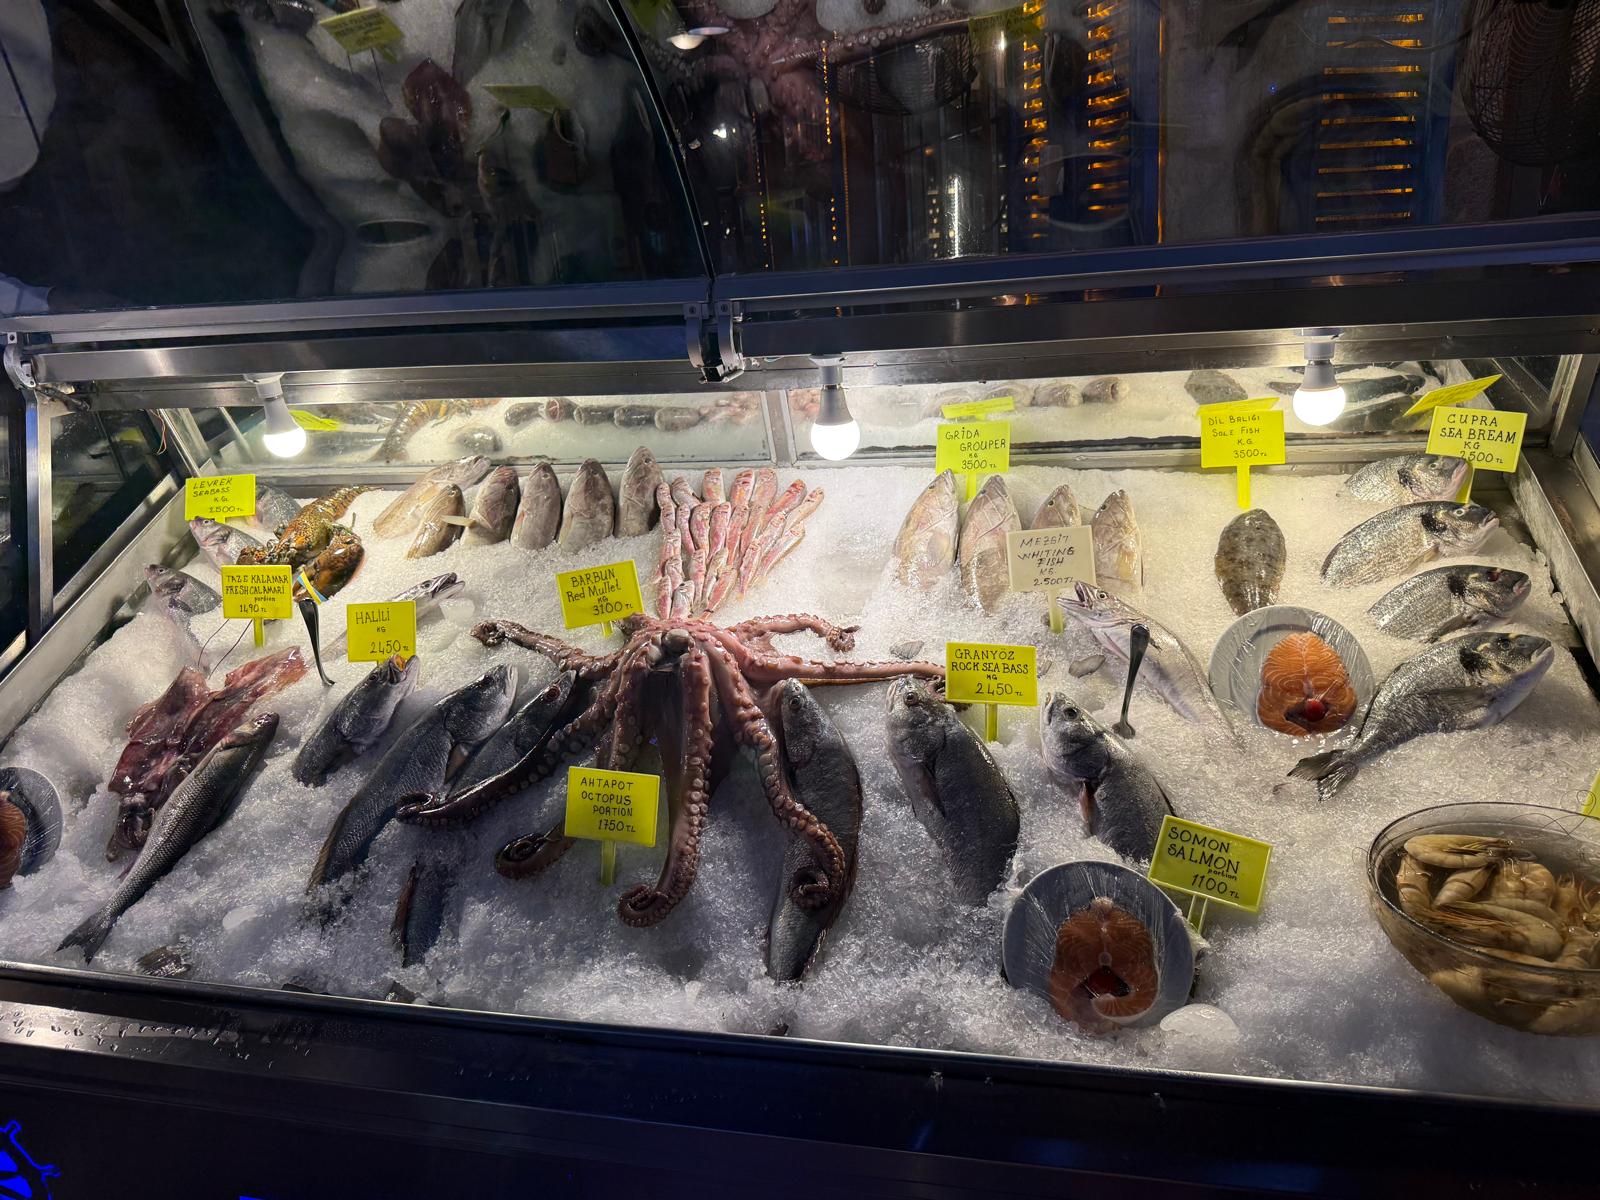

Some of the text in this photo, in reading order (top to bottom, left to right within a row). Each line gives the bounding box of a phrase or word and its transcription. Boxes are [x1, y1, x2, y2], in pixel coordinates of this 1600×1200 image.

[1447, 414, 1498, 427] CUPRA
[945, 427, 979, 440] GRİDA
[1212, 429, 1234, 437] SOLE
[1440, 427, 1517, 444] SEA BREAM
[960, 439, 1006, 451] GROUPER
[1464, 441, 1480, 449] KG
[1233, 449, 1259, 458] 3500
[1460, 450, 1493, 463] 2500
[962, 460, 987, 469] 3500
[193, 478, 232, 489] LEVREK
[1018, 547, 1074, 559] WHITING
[1037, 557, 1064, 567] FISH
[227, 575, 288, 584] TAZE KALAMAR
[571, 569, 615, 587] BARBUN
[566, 579, 621, 602] Red Mullet
[240, 604, 259, 613] 1490
[593, 601, 623, 616] 3100
[370, 640, 401, 654] 2450
[952, 661, 1028, 674] ROCK SEA BASS
[976, 683, 1013, 696] 2450
[581, 777, 633, 791] AHTAPOT
[581, 791, 631, 805] OCTOPUS
[599, 819, 624, 831] 1750
[1168, 826, 1230, 853] SOMON
[1168, 844, 1240, 874] SALMON
[1207, 869, 1237, 880] portion
[1192, 874, 1239, 898] 1100 TL
